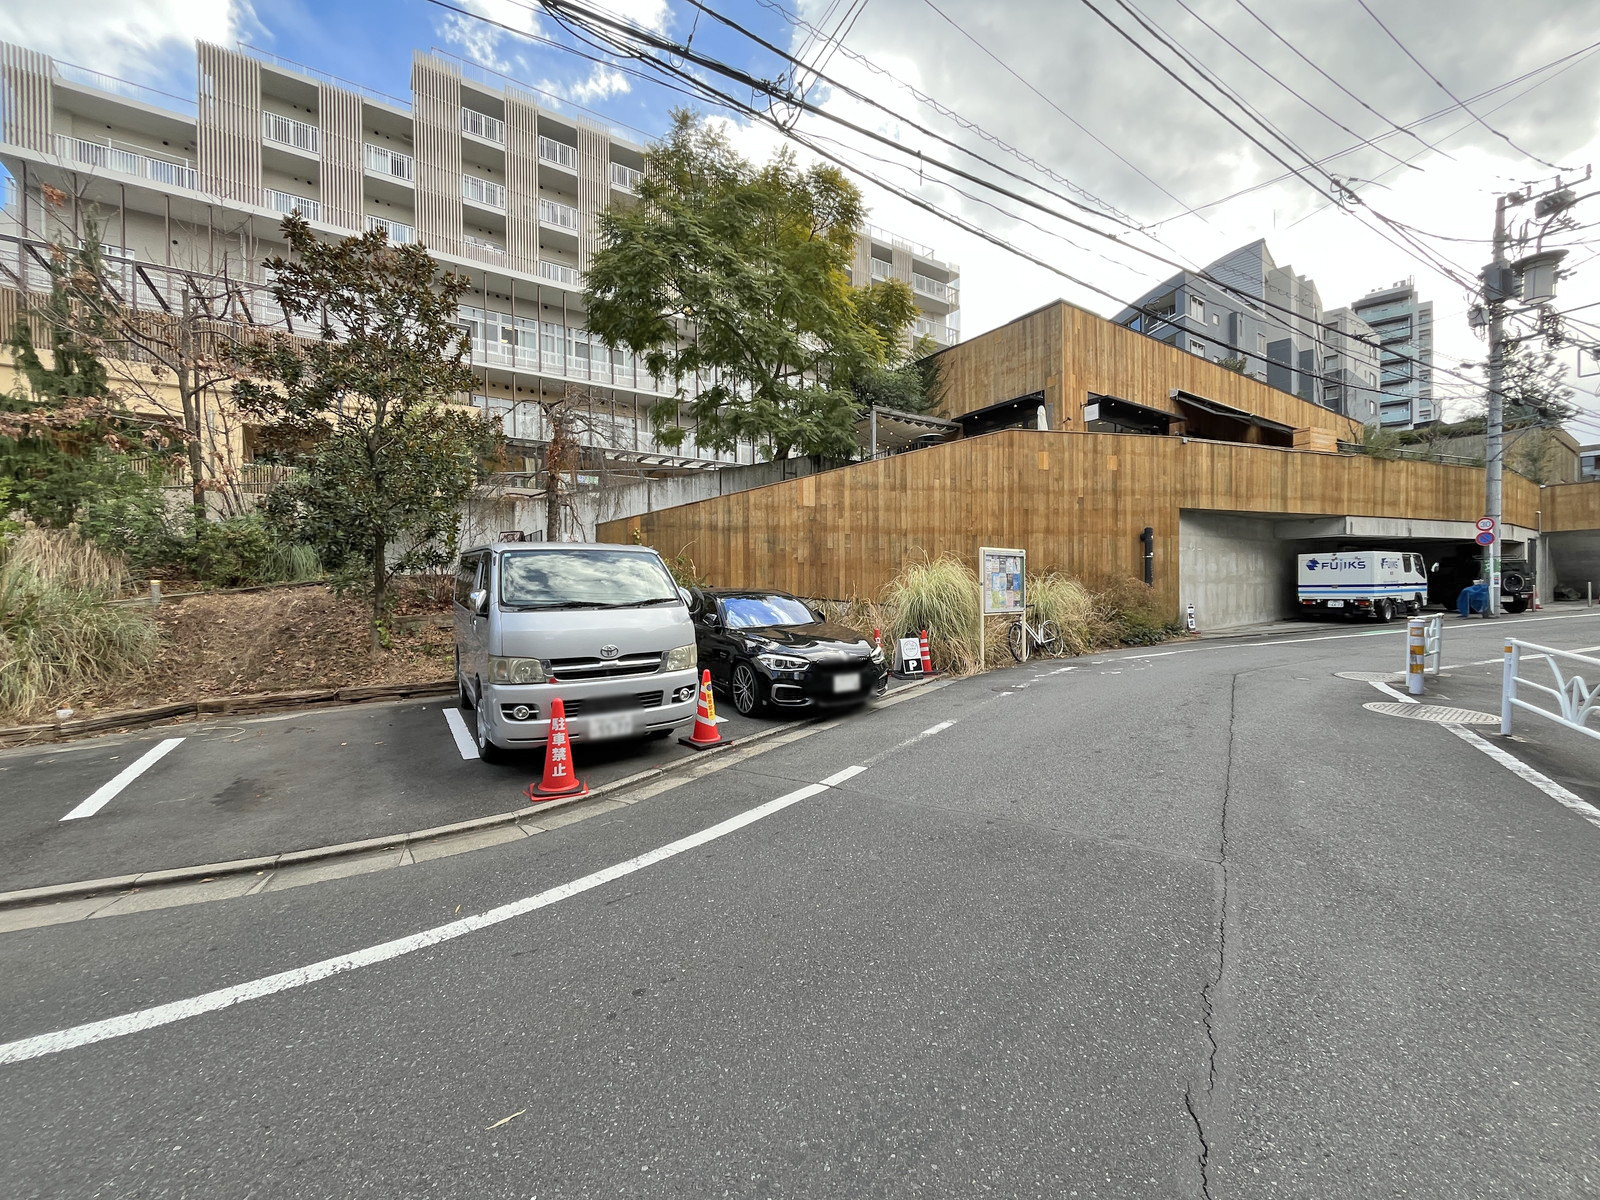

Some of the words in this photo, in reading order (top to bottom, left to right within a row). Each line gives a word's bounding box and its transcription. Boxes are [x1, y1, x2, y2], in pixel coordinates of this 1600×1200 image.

[909, 660, 918, 671] P
[552, 717, 566, 776] 駐車禁止
